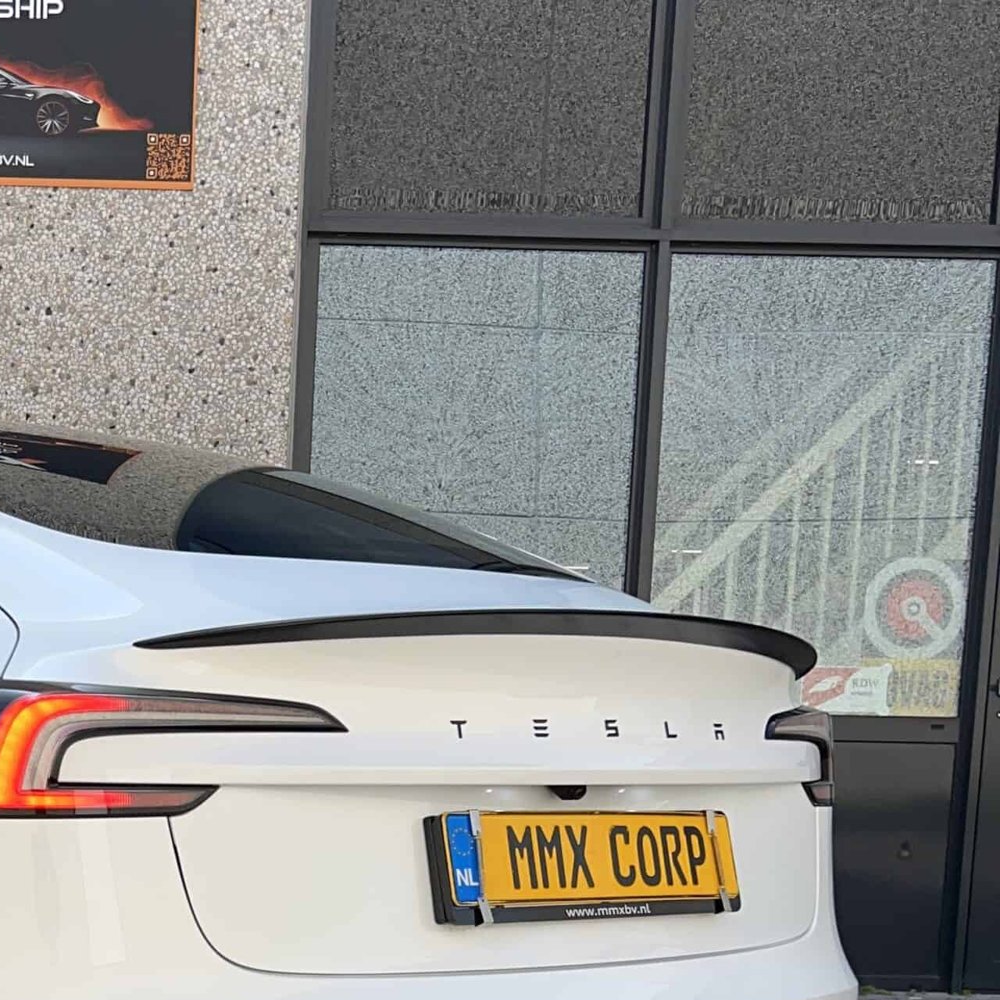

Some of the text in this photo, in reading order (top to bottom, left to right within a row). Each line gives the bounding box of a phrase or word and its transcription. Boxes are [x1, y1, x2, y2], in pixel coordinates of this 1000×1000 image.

[450, 719, 726, 741] TESLA
[506, 824, 707, 891] MMX CORP
[456, 868, 479, 888] NL
[566, 902, 652, 918] www.mmxbv.nl
